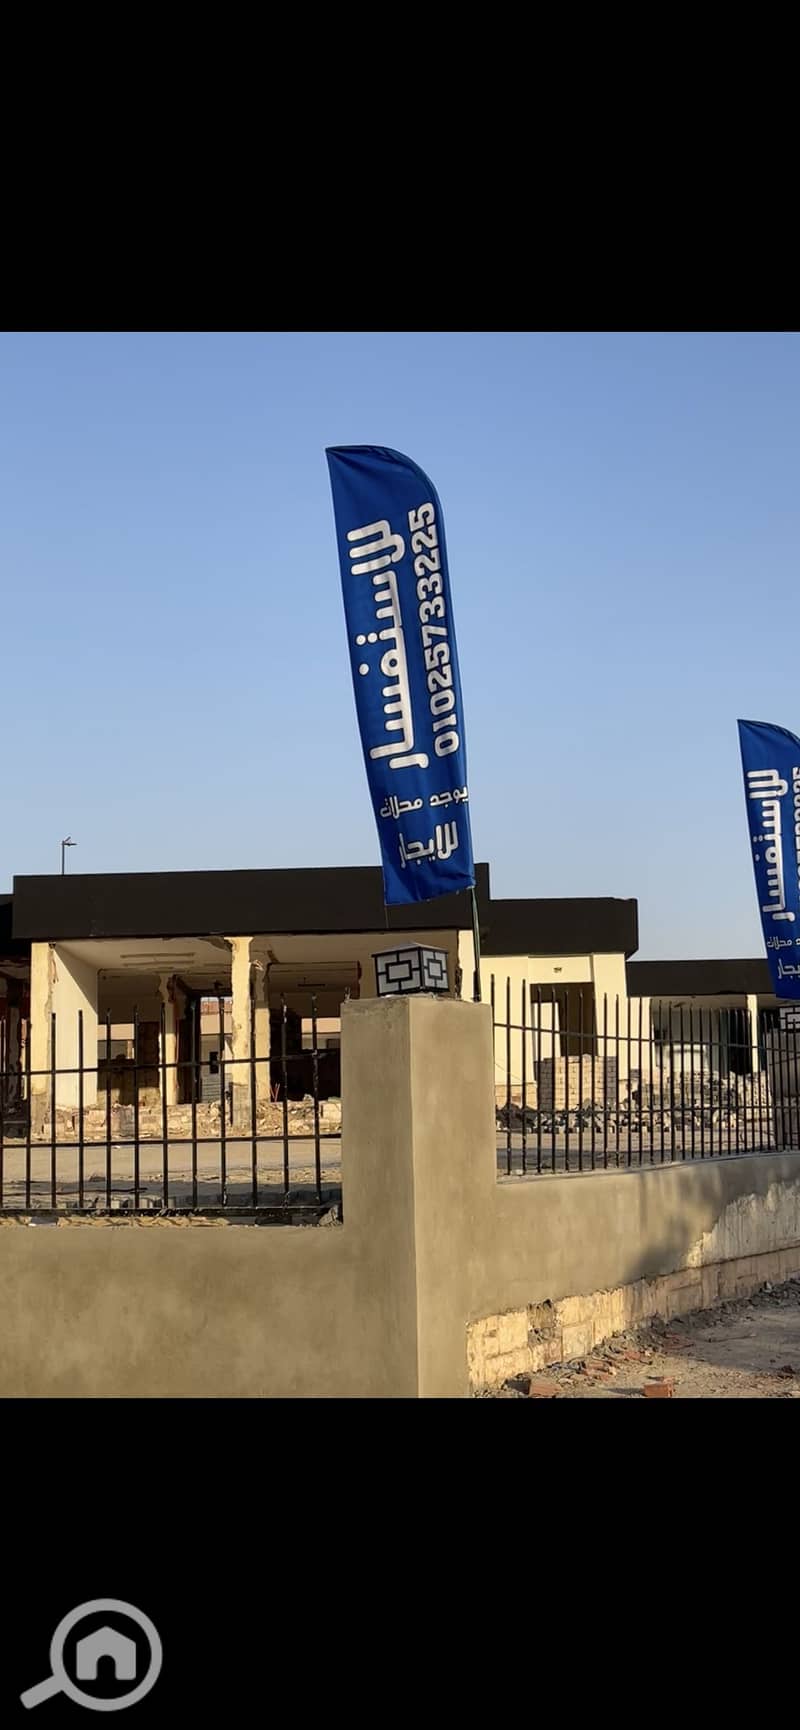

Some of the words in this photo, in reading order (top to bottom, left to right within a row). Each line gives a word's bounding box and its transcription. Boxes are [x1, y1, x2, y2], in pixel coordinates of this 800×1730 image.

[346, 519, 430, 770] للاستفسار
[407, 501, 460, 758] 01025733225
[380, 795, 423, 820] محلات
[430, 786, 469, 808] يوجد
[746, 768, 796, 922] للاستفسار
